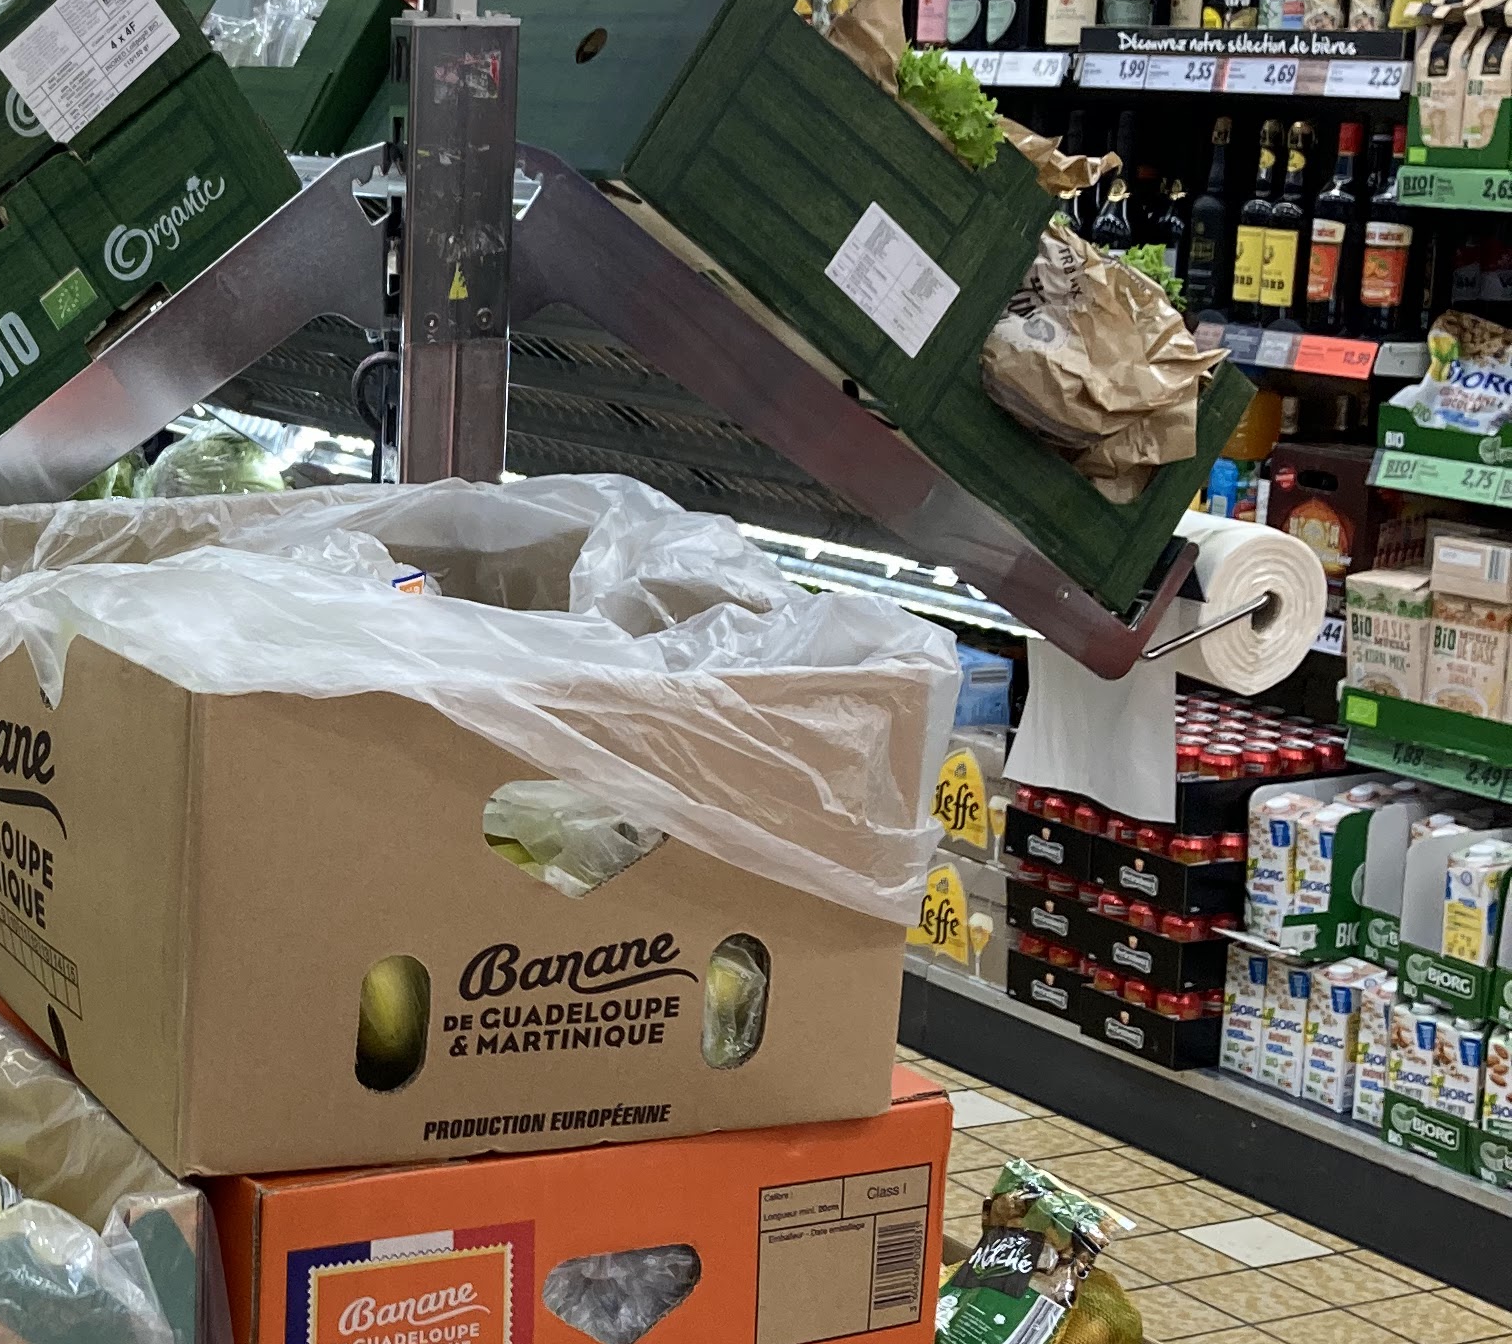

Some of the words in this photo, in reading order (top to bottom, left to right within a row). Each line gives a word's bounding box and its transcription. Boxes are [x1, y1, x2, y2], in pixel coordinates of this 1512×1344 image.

[125, 21, 138, 38] 4F
[1117, 32, 1186, 52] Découvrez
[1188, 34, 1225, 54] notre
[1228, 34, 1286, 55] sélection
[1289, 34, 1309, 54] de
[1311, 34, 1357, 56] bières
[1118, 59, 1145, 78] 1,99
[1185, 61, 1213, 80] 2,55
[1263, 64, 1296, 83] 2,69
[1367, 66, 1402, 85] 2,29
[1402, 174, 1435, 197] BIO!
[103, 174, 226, 282] Organic
[1434, 625, 1457, 650] BiO
[933, 780, 980, 831] Leffe
[918, 895, 960, 944] Leffe
[458, 931, 700, 1002] Banane
[443, 1014, 473, 1032] DE
[479, 996, 681, 1030] GUADELOUPE
[448, 1034, 468, 1057] &
[476, 1022, 666, 1056] MARTINIQUE
[423, 1113, 547, 1142] PRODUCTION
[550, 1103, 672, 1132] EUROPÉENNE
[866, 1184, 901, 1201] Class
[337, 1279, 491, 1335] Banane
